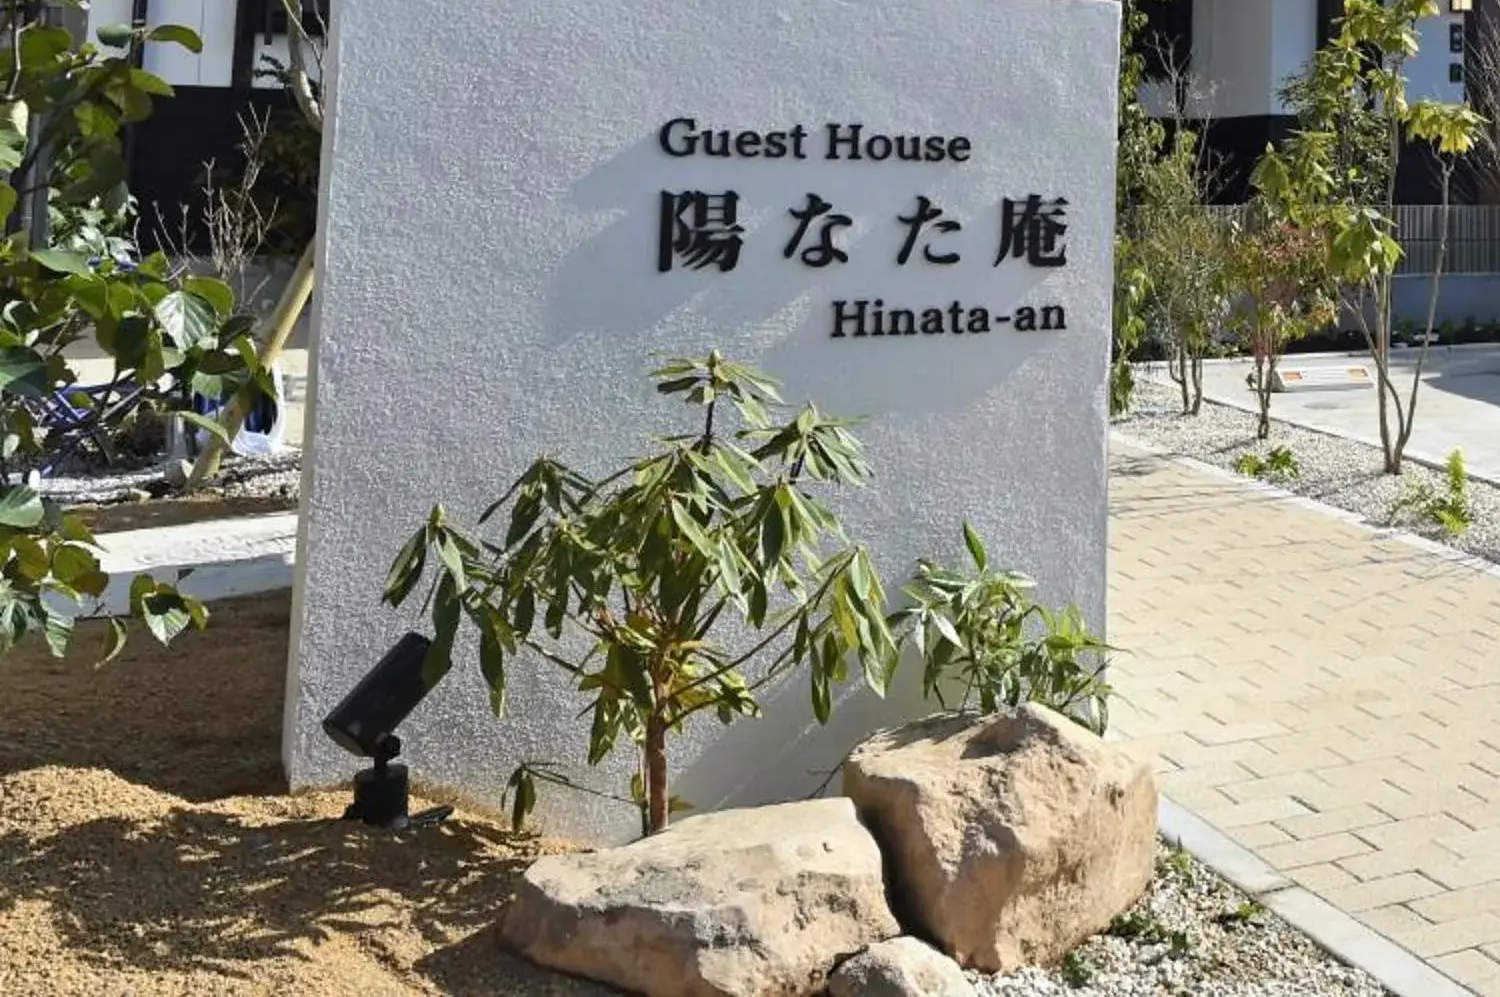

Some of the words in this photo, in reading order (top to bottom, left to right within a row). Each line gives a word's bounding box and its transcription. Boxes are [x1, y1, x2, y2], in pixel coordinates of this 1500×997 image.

[658, 117, 808, 160] Guest
[824, 123, 972, 162] House
[657, 189, 1070, 274] 陽なた庵
[829, 299, 1067, 338] Hinata-an
